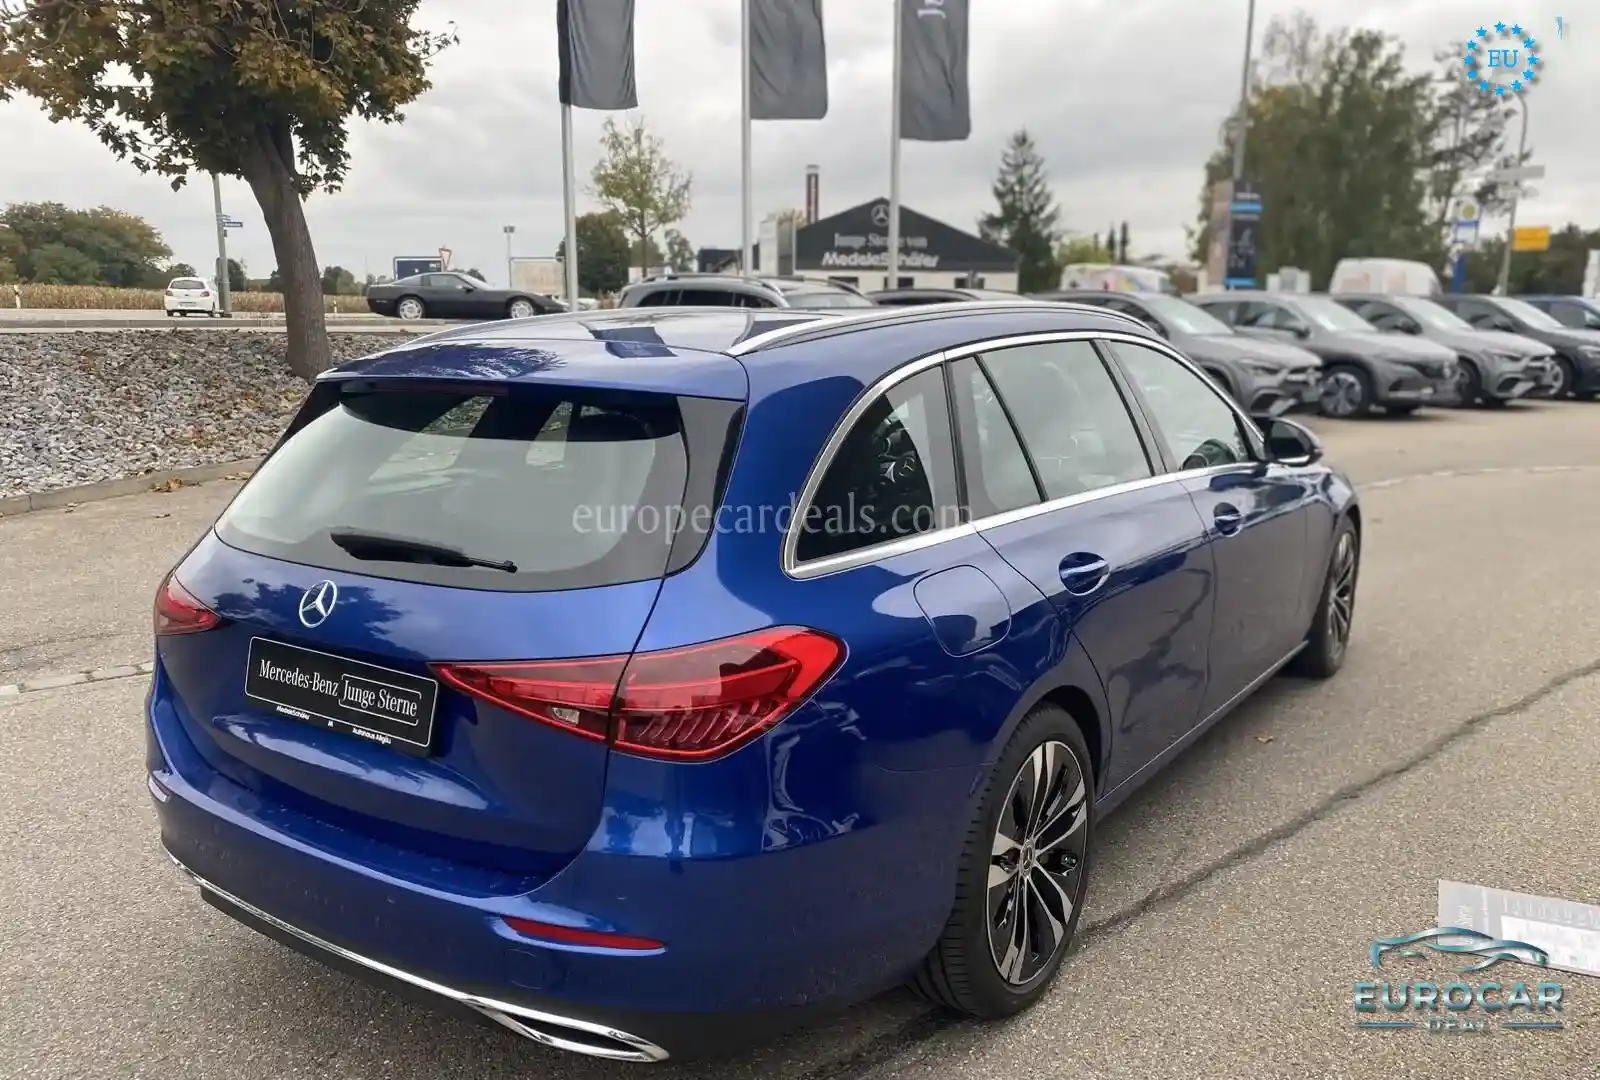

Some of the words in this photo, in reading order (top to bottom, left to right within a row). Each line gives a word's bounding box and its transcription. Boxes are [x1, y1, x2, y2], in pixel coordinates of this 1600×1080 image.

[259, 659, 339, 698] Mercedes-Benz
[342, 679, 375, 709] Junge
[377, 688, 418, 717] Sterne
